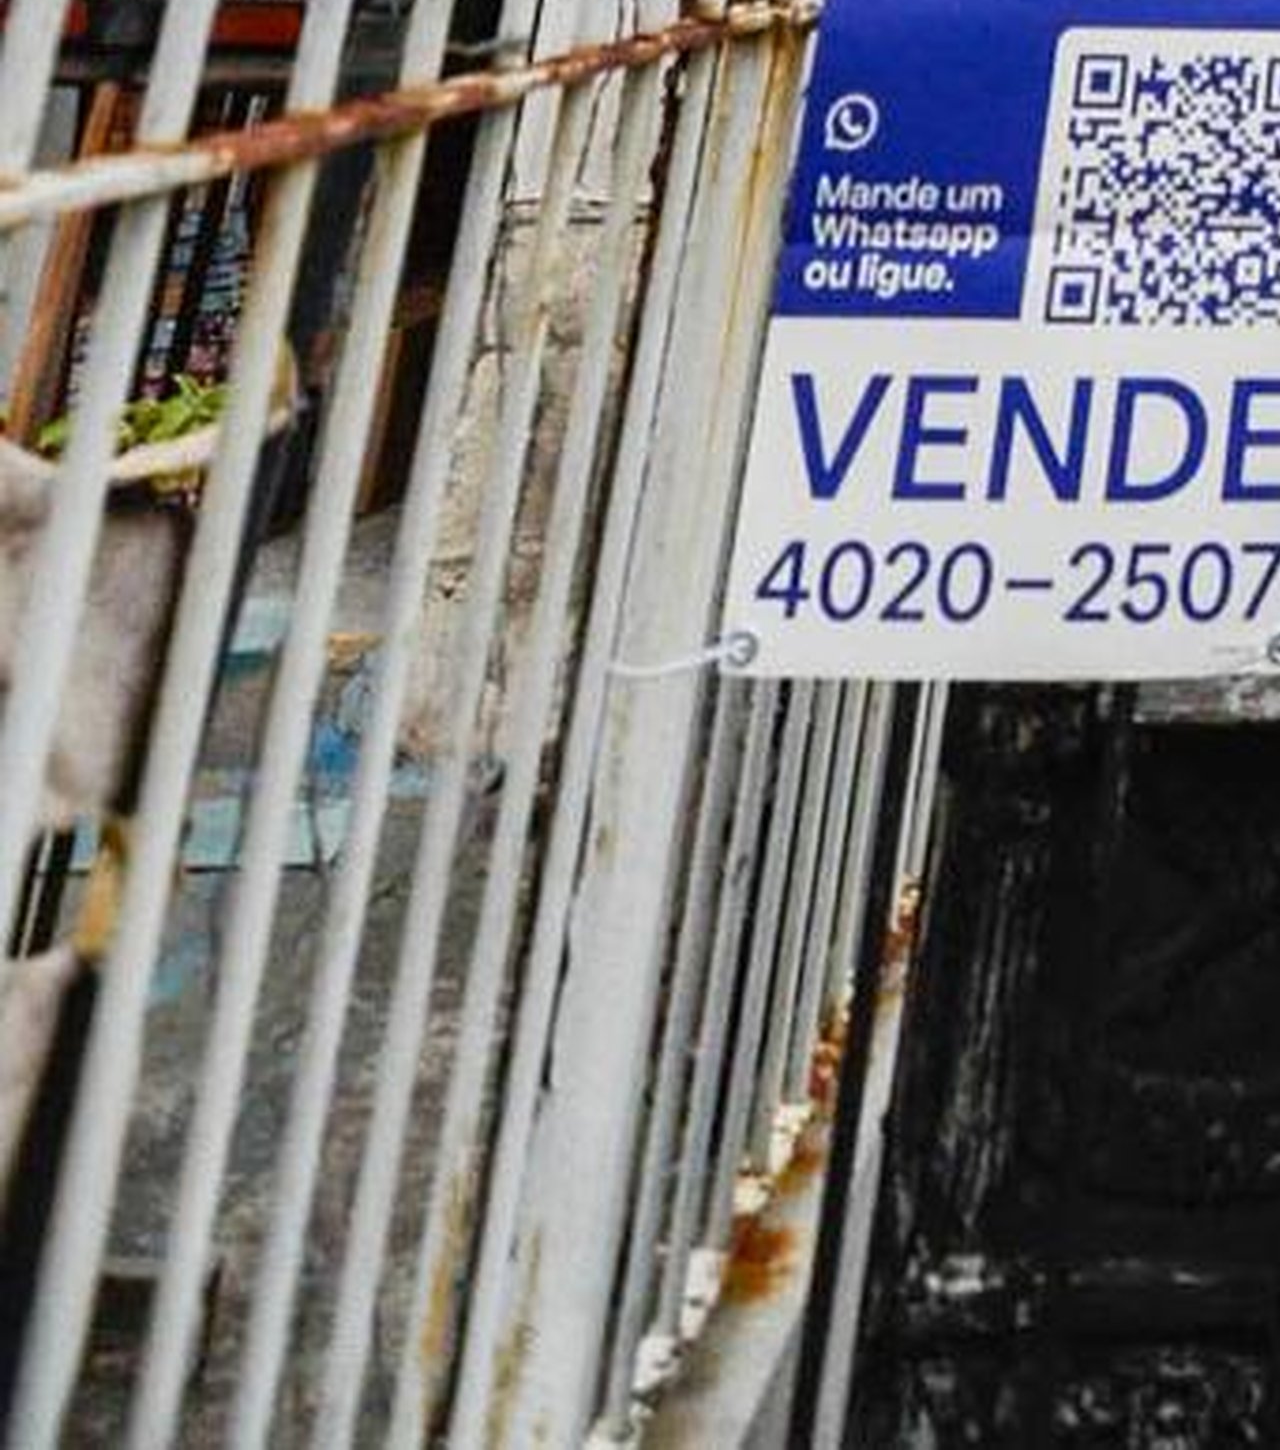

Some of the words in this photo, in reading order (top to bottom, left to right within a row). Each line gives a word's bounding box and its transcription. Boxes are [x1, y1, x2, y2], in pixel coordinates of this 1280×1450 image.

[816, 171, 942, 212] Mande
[946, 182, 1004, 213] um
[812, 212, 999, 259] Whatsapp
[804, 258, 852, 290] ou
[857, 253, 955, 300] ligue.
